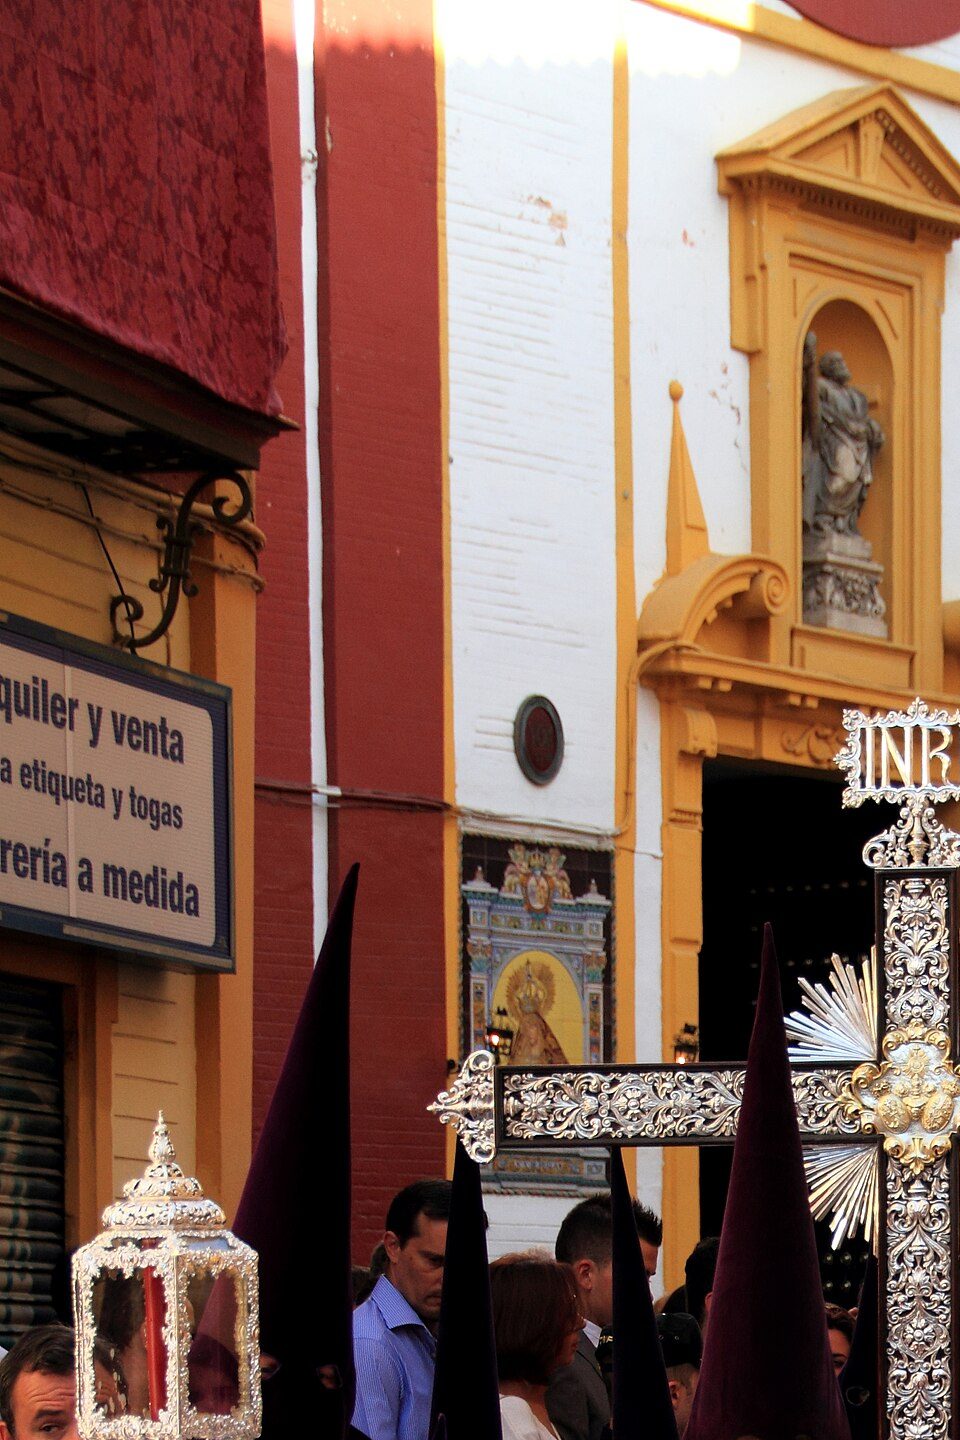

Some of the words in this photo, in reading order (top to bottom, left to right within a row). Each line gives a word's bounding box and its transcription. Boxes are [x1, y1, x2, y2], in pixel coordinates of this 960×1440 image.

[87, 702, 103, 749] y
[111, 709, 185, 764] venta
[20, 758, 105, 810] etiqueta
[112, 786, 123, 821] y
[129, 786, 183, 831] togas
[78, 857, 94, 894] a
[103, 861, 200, 917] medida
